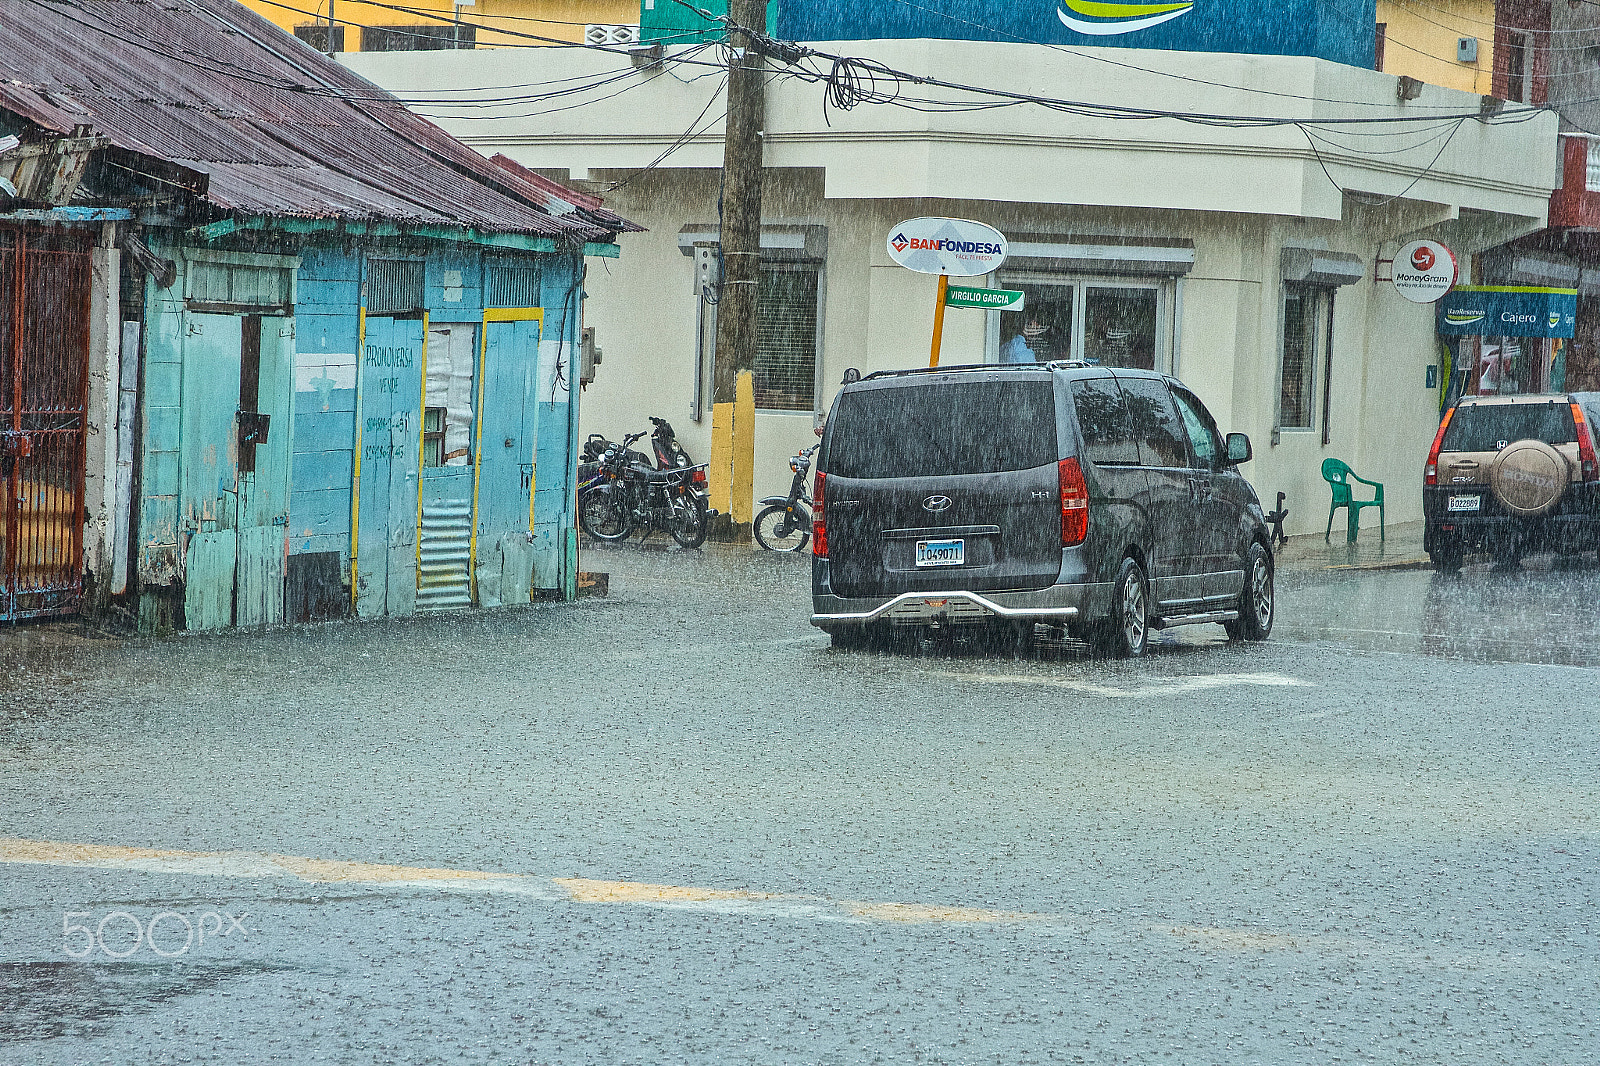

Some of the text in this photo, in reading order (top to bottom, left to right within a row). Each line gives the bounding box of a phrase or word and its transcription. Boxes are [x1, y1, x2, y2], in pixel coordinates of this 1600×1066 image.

[910, 238, 1002, 254] BANFONDESA
[1396, 273, 1448, 283] MoneyGram
[950, 291, 981, 302] VIRGILIO
[1501, 312, 1536, 325] Cajero
[1503, 468, 1555, 488] HONDA
